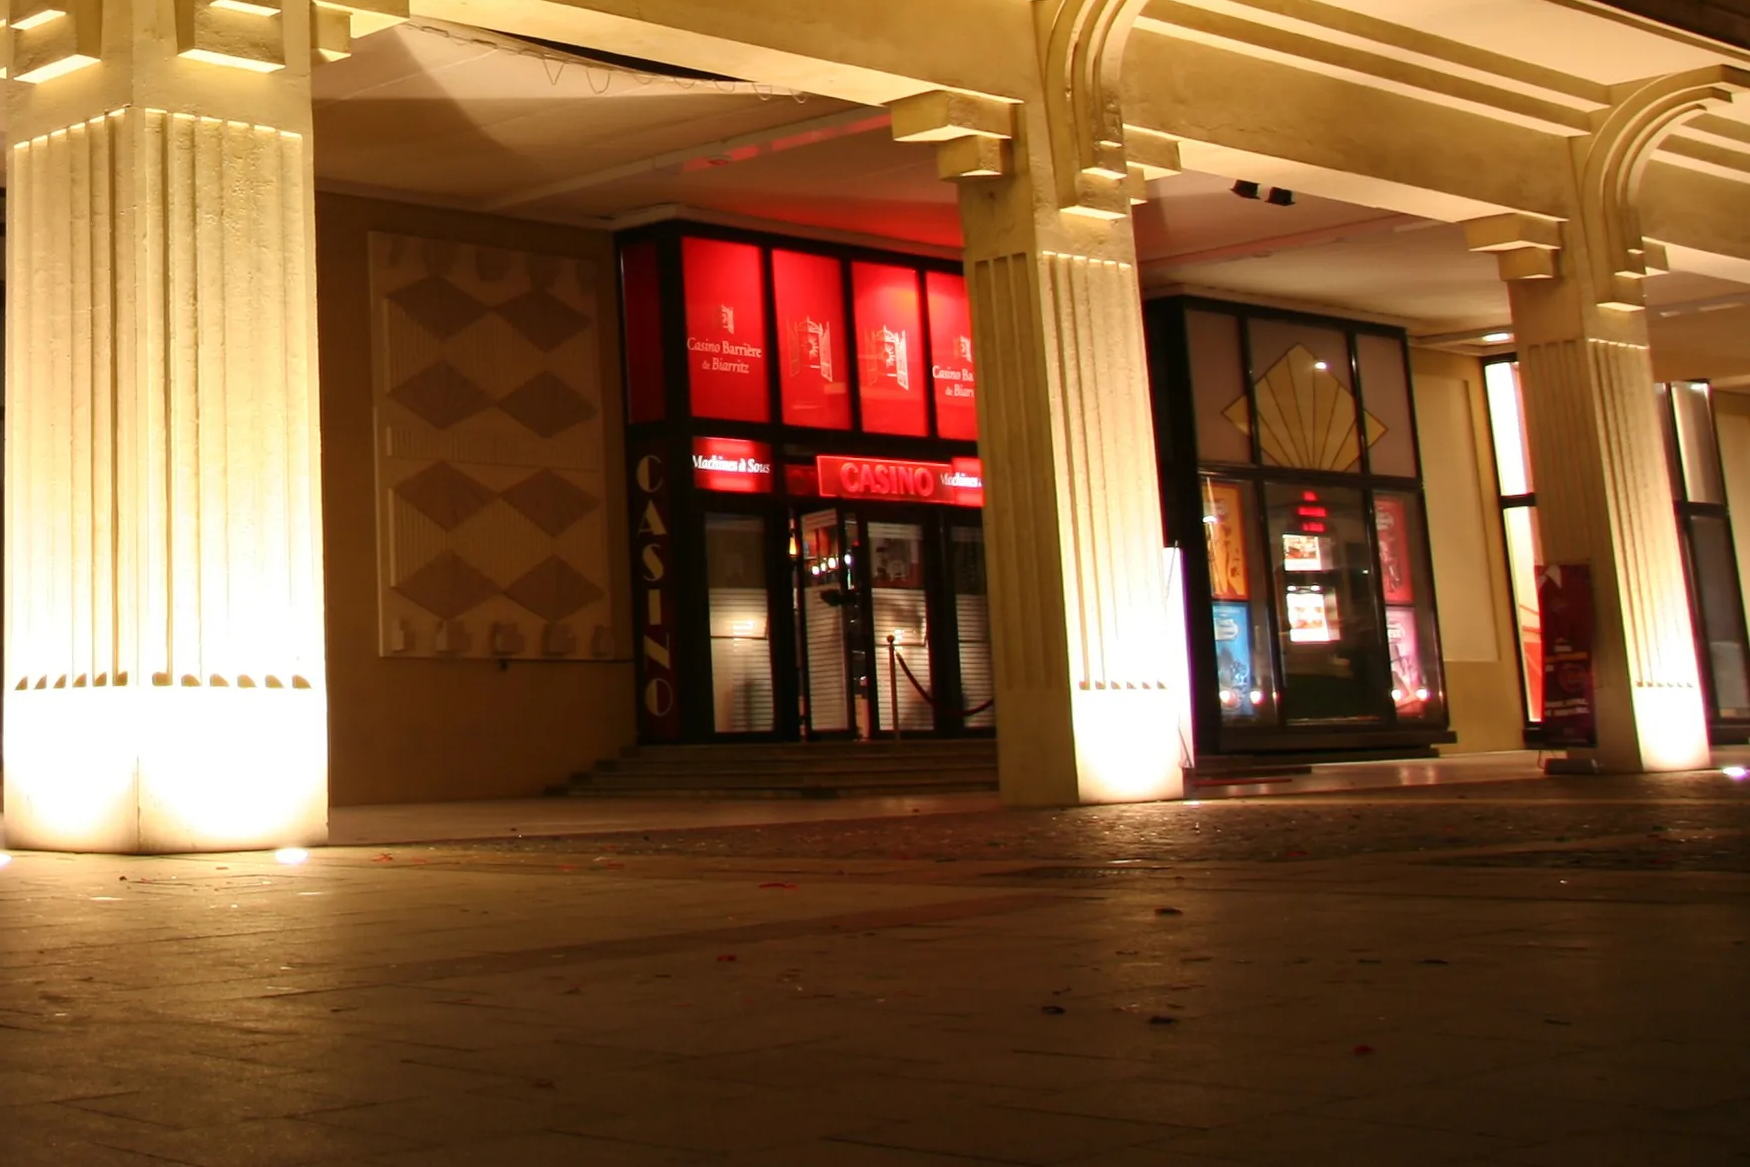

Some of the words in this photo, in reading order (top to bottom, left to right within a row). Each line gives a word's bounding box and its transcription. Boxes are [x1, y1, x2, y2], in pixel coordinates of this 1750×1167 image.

[687, 337, 721, 353] Casino
[722, 340, 762, 358] Barrière
[712, 357, 749, 373] Biarritz
[932, 365, 961, 380] Casino
[693, 454, 738, 471] Machines
[748, 458, 771, 473] Sous
[841, 462, 934, 496] CASINO
[636, 455, 673, 717] CASINO
